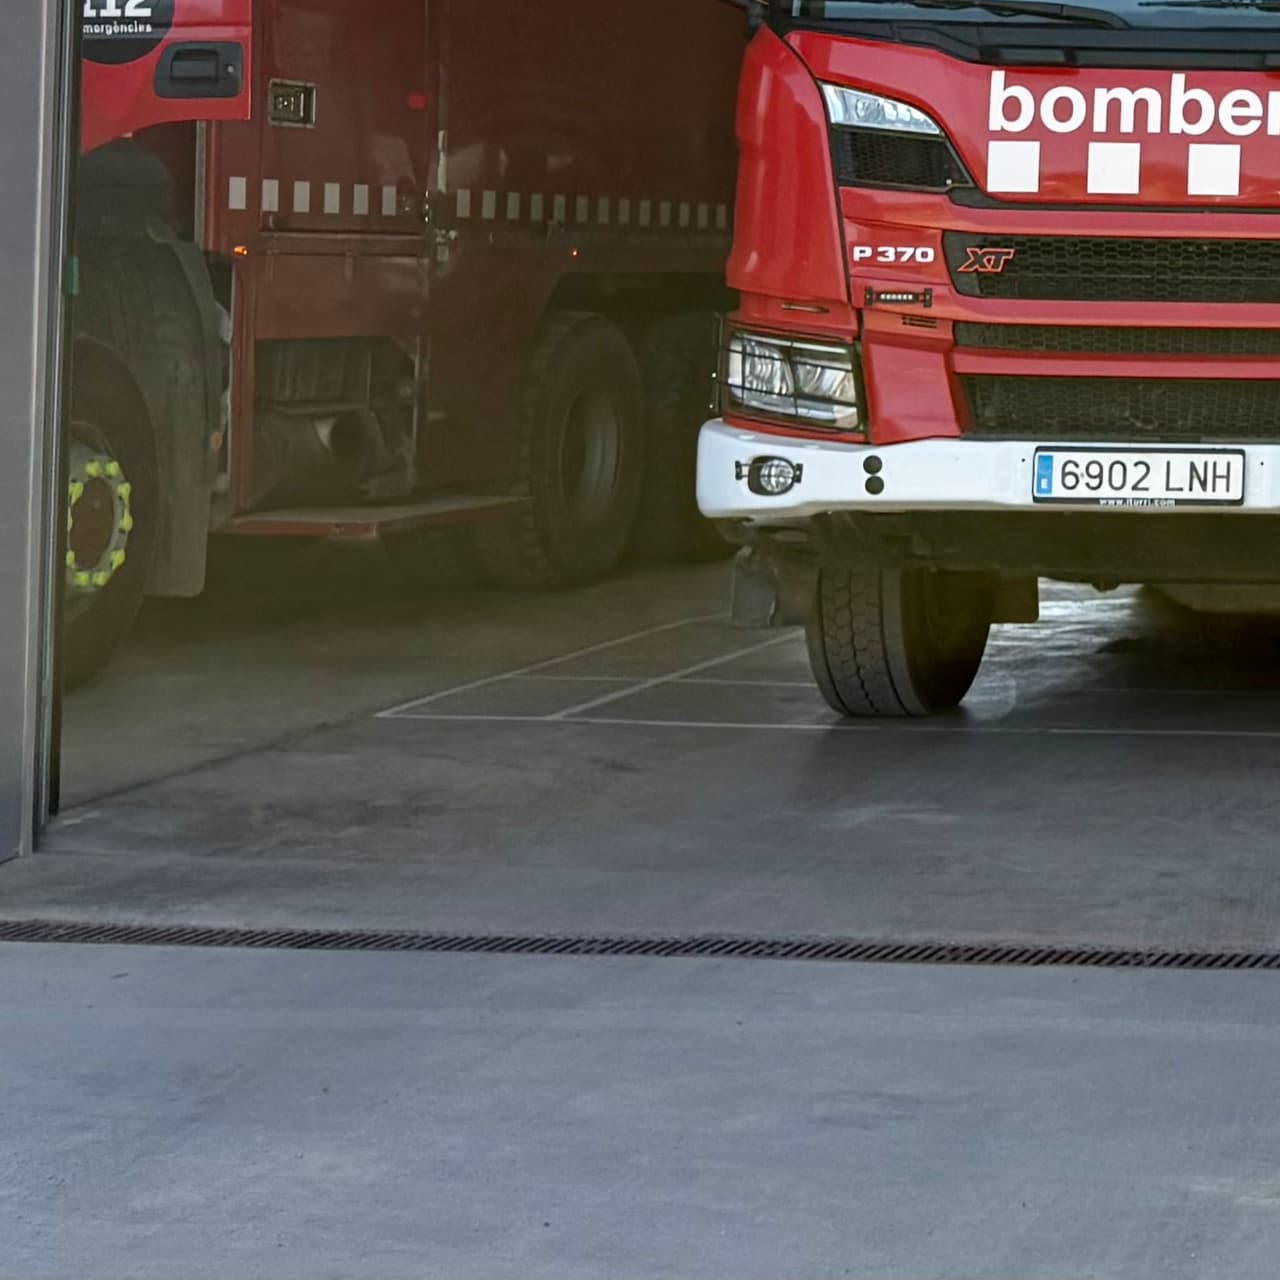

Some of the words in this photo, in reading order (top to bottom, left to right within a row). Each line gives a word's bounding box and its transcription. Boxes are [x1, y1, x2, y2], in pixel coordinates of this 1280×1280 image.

[83, 21, 152, 35] mergències
[853, 246, 872, 262] P
[877, 246, 935, 263] 370
[957, 247, 1016, 273] XT
[1060, 459, 1151, 491] 6902
[1165, 460, 1232, 493] LNH
